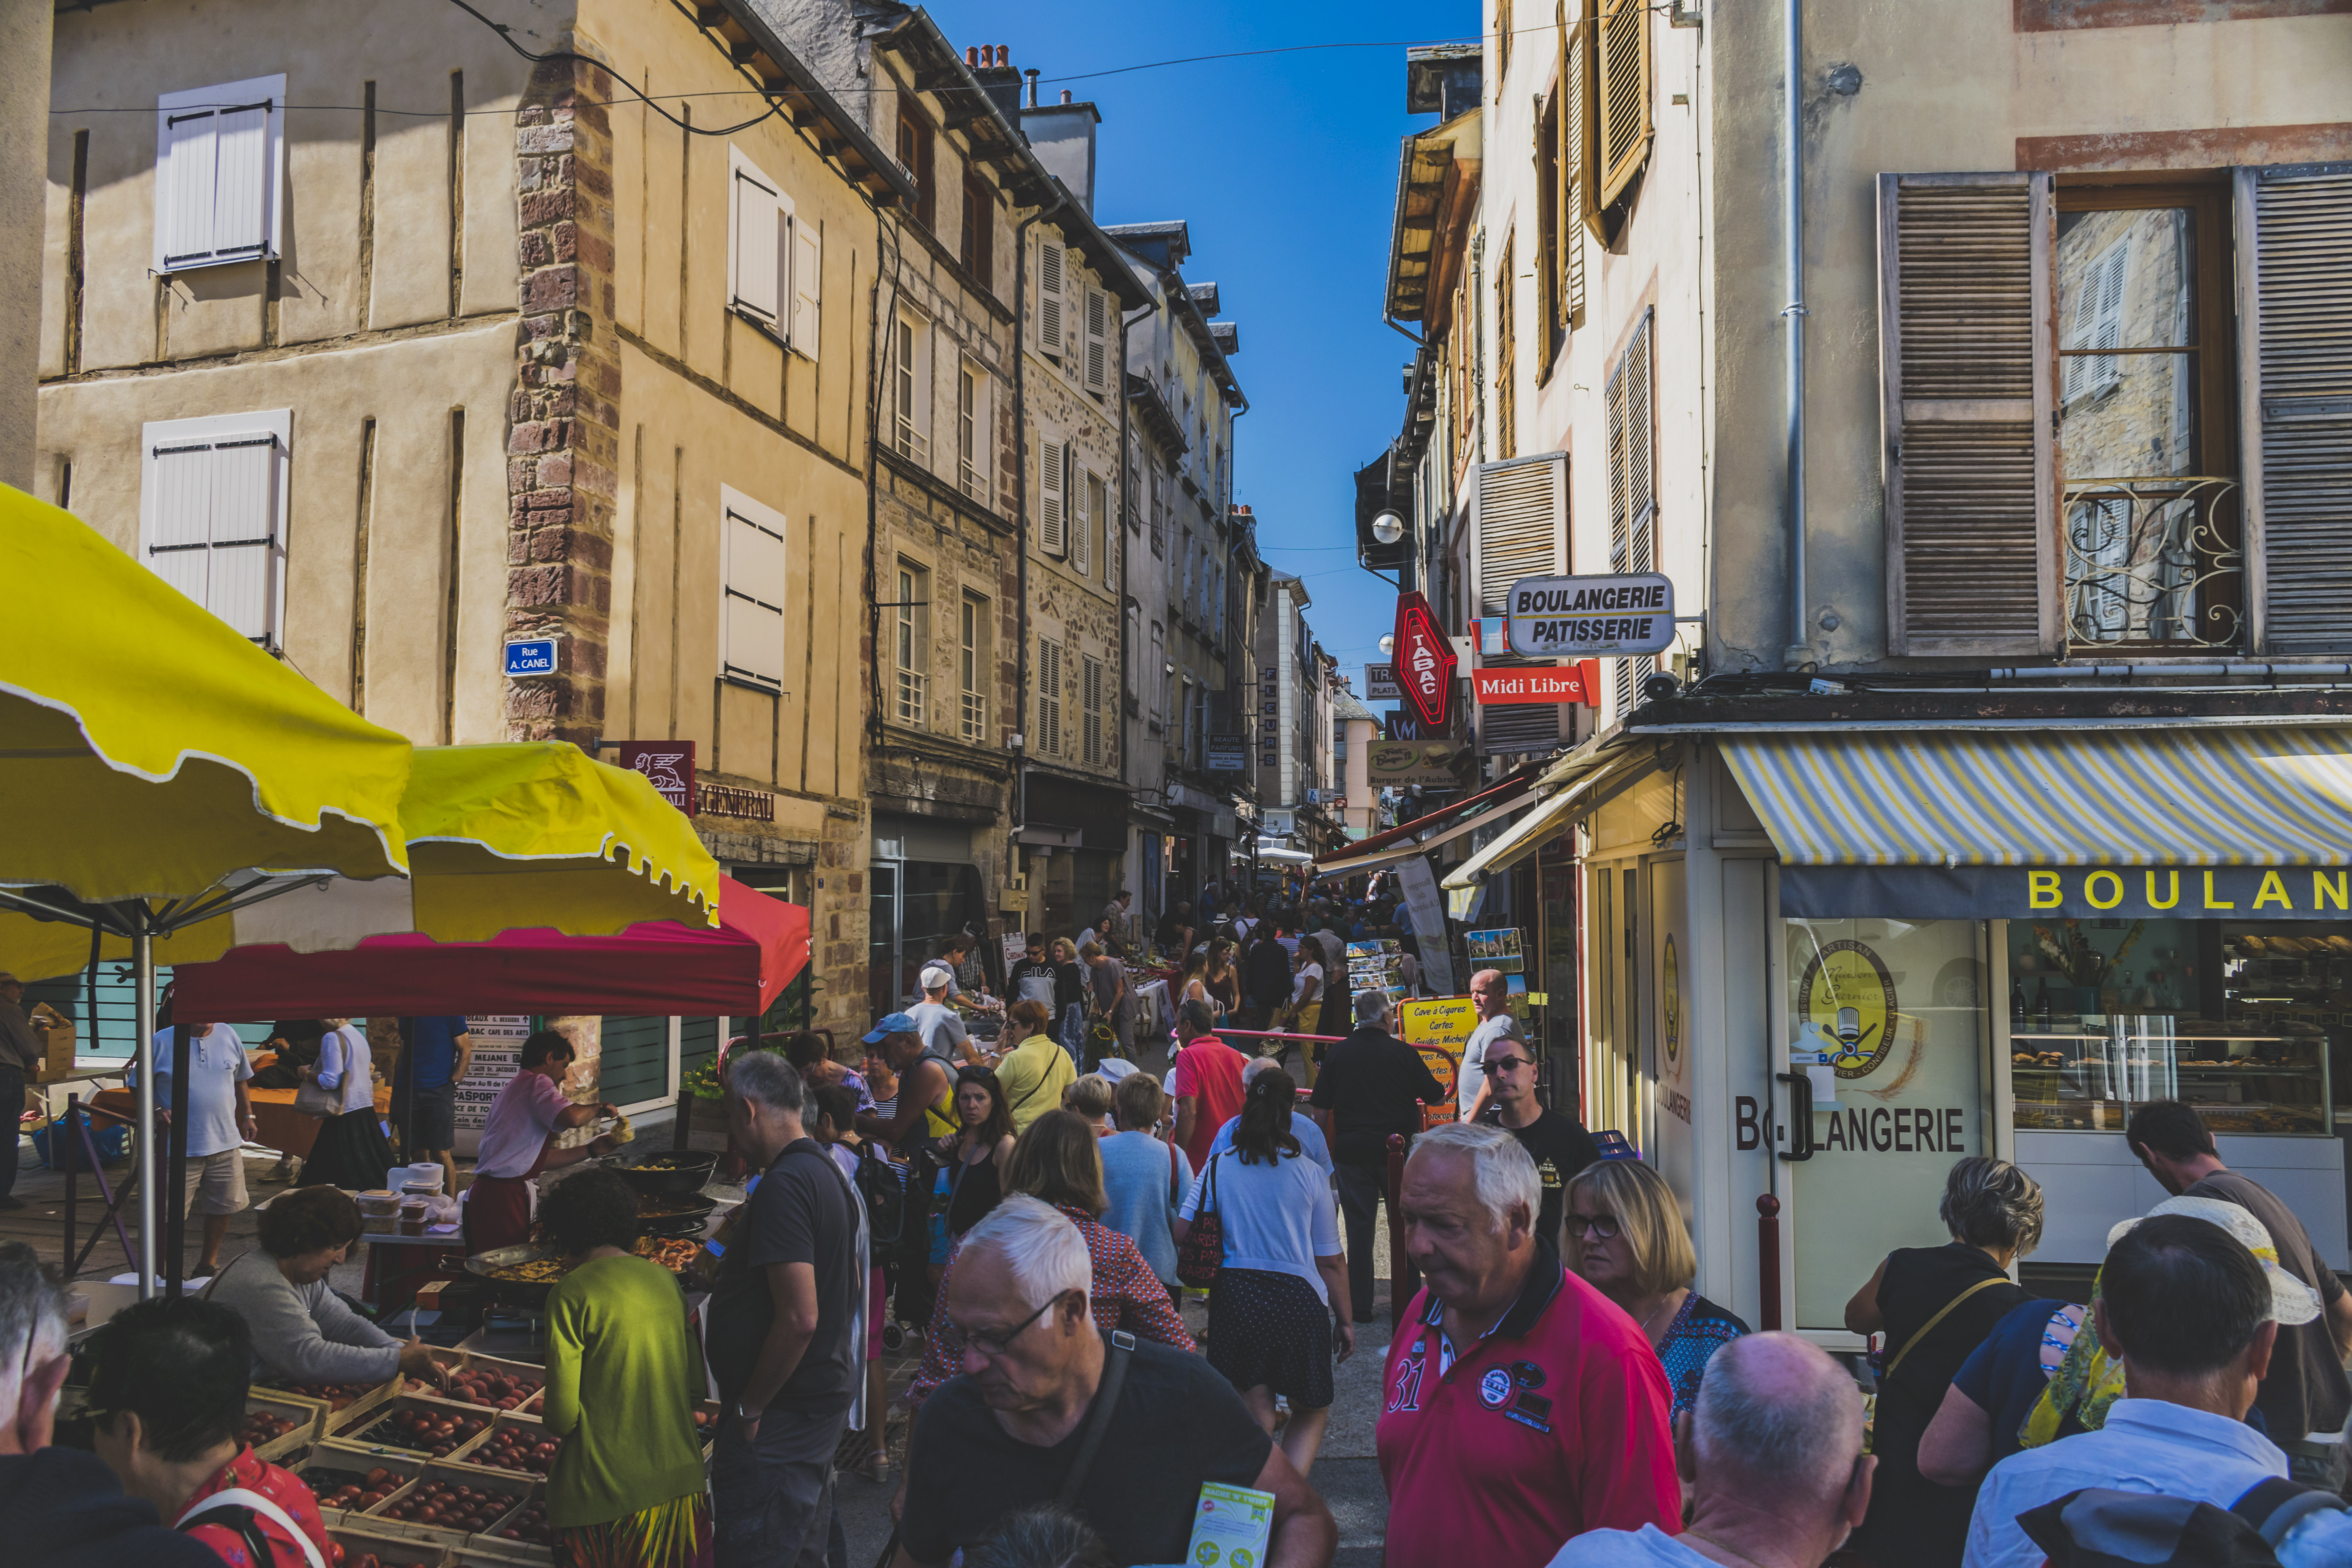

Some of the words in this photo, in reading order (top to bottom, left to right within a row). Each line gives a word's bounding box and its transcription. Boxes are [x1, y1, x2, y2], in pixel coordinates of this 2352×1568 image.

[1516, 586, 1665, 613] BOULANGERIE
[1533, 618, 1653, 642] PATISSERIE
[522, 647, 538, 656] Rue
[510, 660, 520, 669] A.
[521, 658, 550, 668] CANEL
[1413, 634, 1436, 695] TABAC
[1481, 679, 1524, 694] Midi
[1530, 678, 1580, 694] Libre
[1266, 670, 1275, 764] FLEURS
[1370, 776, 1401, 785] Burger
[704, 785, 775, 822] GENERALI
[1821, 942, 1871, 957] ARTISAN
[1820, 966, 1873, 982] Maison
[1821, 985, 1880, 1005] Garnier
[1884, 979, 1895, 1019] GLACIER
[1414, 1008, 1431, 1016] Cave
[1433, 1006, 1437, 1015] à
[1439, 1006, 1466, 1016] Cigares
[1429, 1021, 1453, 1030] Cartes
[1862, 1028, 1892, 1074] CONFISEUR
[1388, 1359, 1426, 1413] 31
[1243, 1495, 1268, 1506] TWIST
